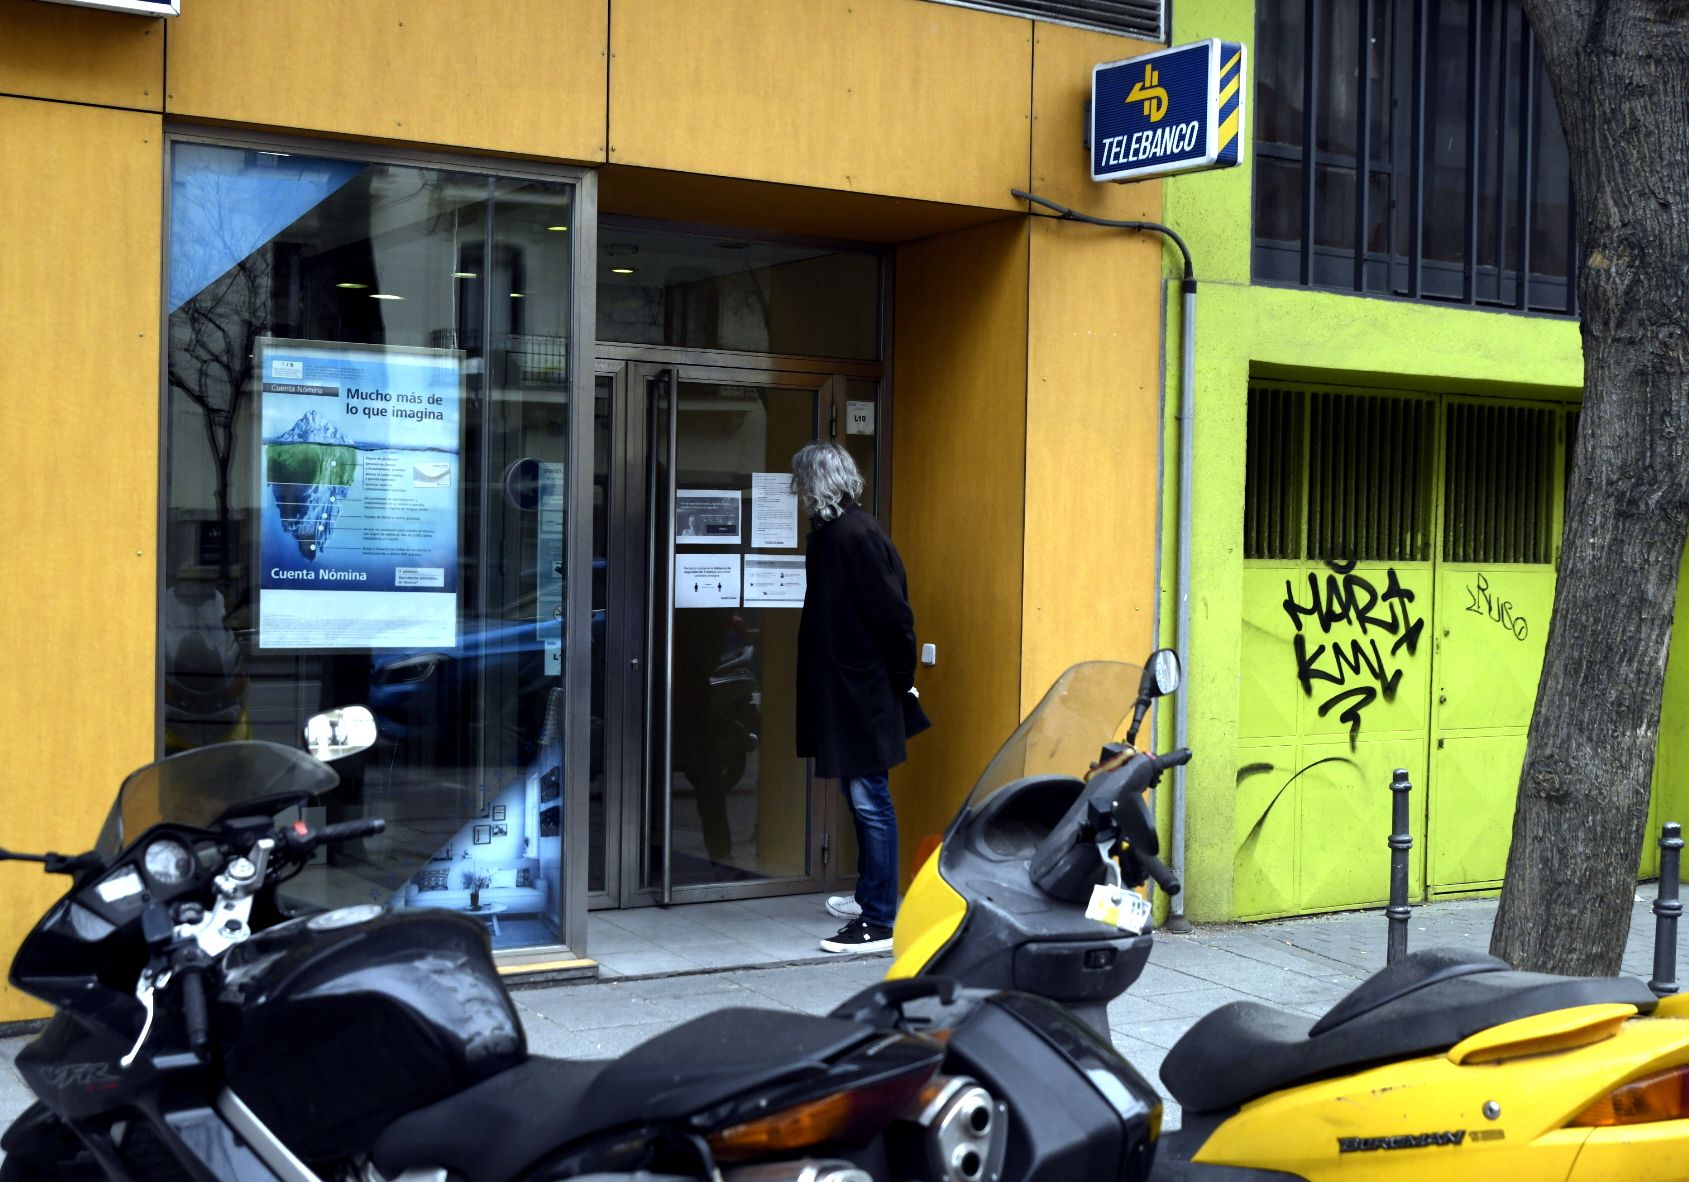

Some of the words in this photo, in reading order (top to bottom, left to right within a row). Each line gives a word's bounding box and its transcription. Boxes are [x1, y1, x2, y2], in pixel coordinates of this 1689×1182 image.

[1102, 121, 1199, 167] TELEBANCO
[271, 384, 296, 392] Cuenta
[297, 385, 324, 394] Nómina
[346, 388, 392, 402] Mucho
[396, 392, 423, 404] más
[427, 393, 443, 406] de
[346, 402, 359, 415] lo
[362, 406, 388, 419] que
[392, 405, 444, 422] imagina
[271, 568, 315, 580] Cuenta
[319, 567, 367, 581] Nómina
[1336, 1129, 1467, 1154] BURGMAN
